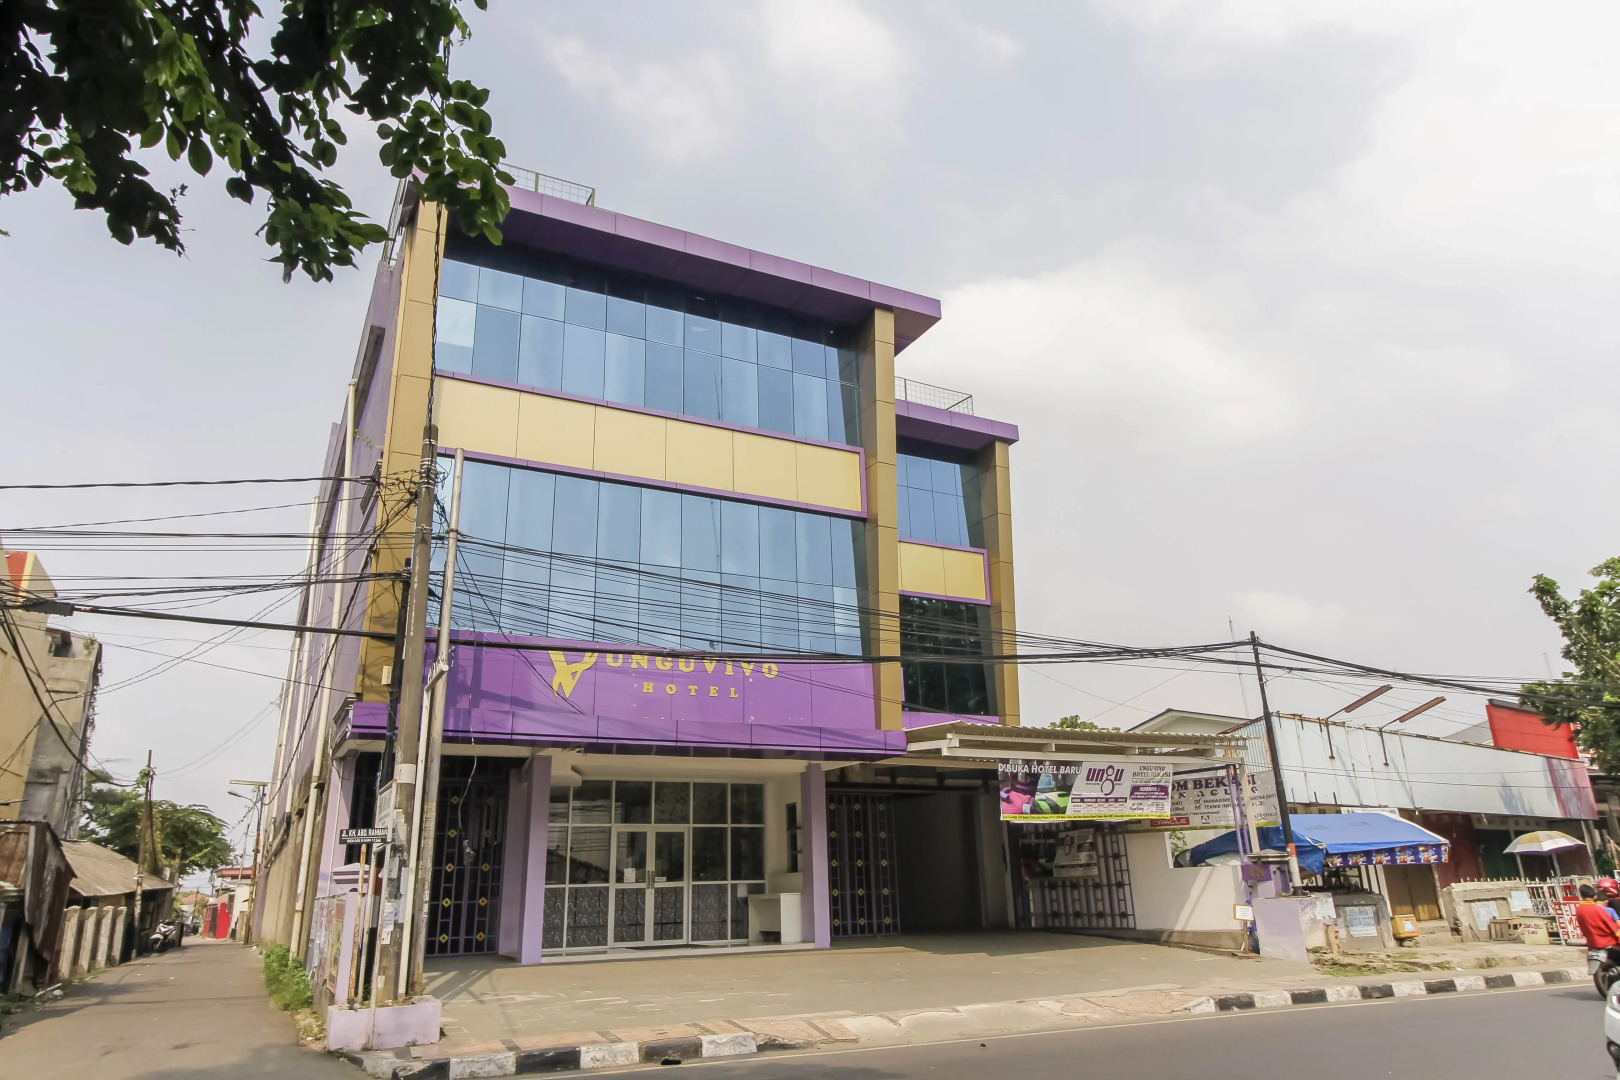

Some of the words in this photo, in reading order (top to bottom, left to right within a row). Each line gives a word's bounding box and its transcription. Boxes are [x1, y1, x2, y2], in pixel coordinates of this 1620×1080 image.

[642, 682, 739, 698] HOTEL
[1031, 764, 1058, 774] HOTEL
[1059, 765, 1082, 775] BARU
[1192, 774, 1257, 791] BEKAI
